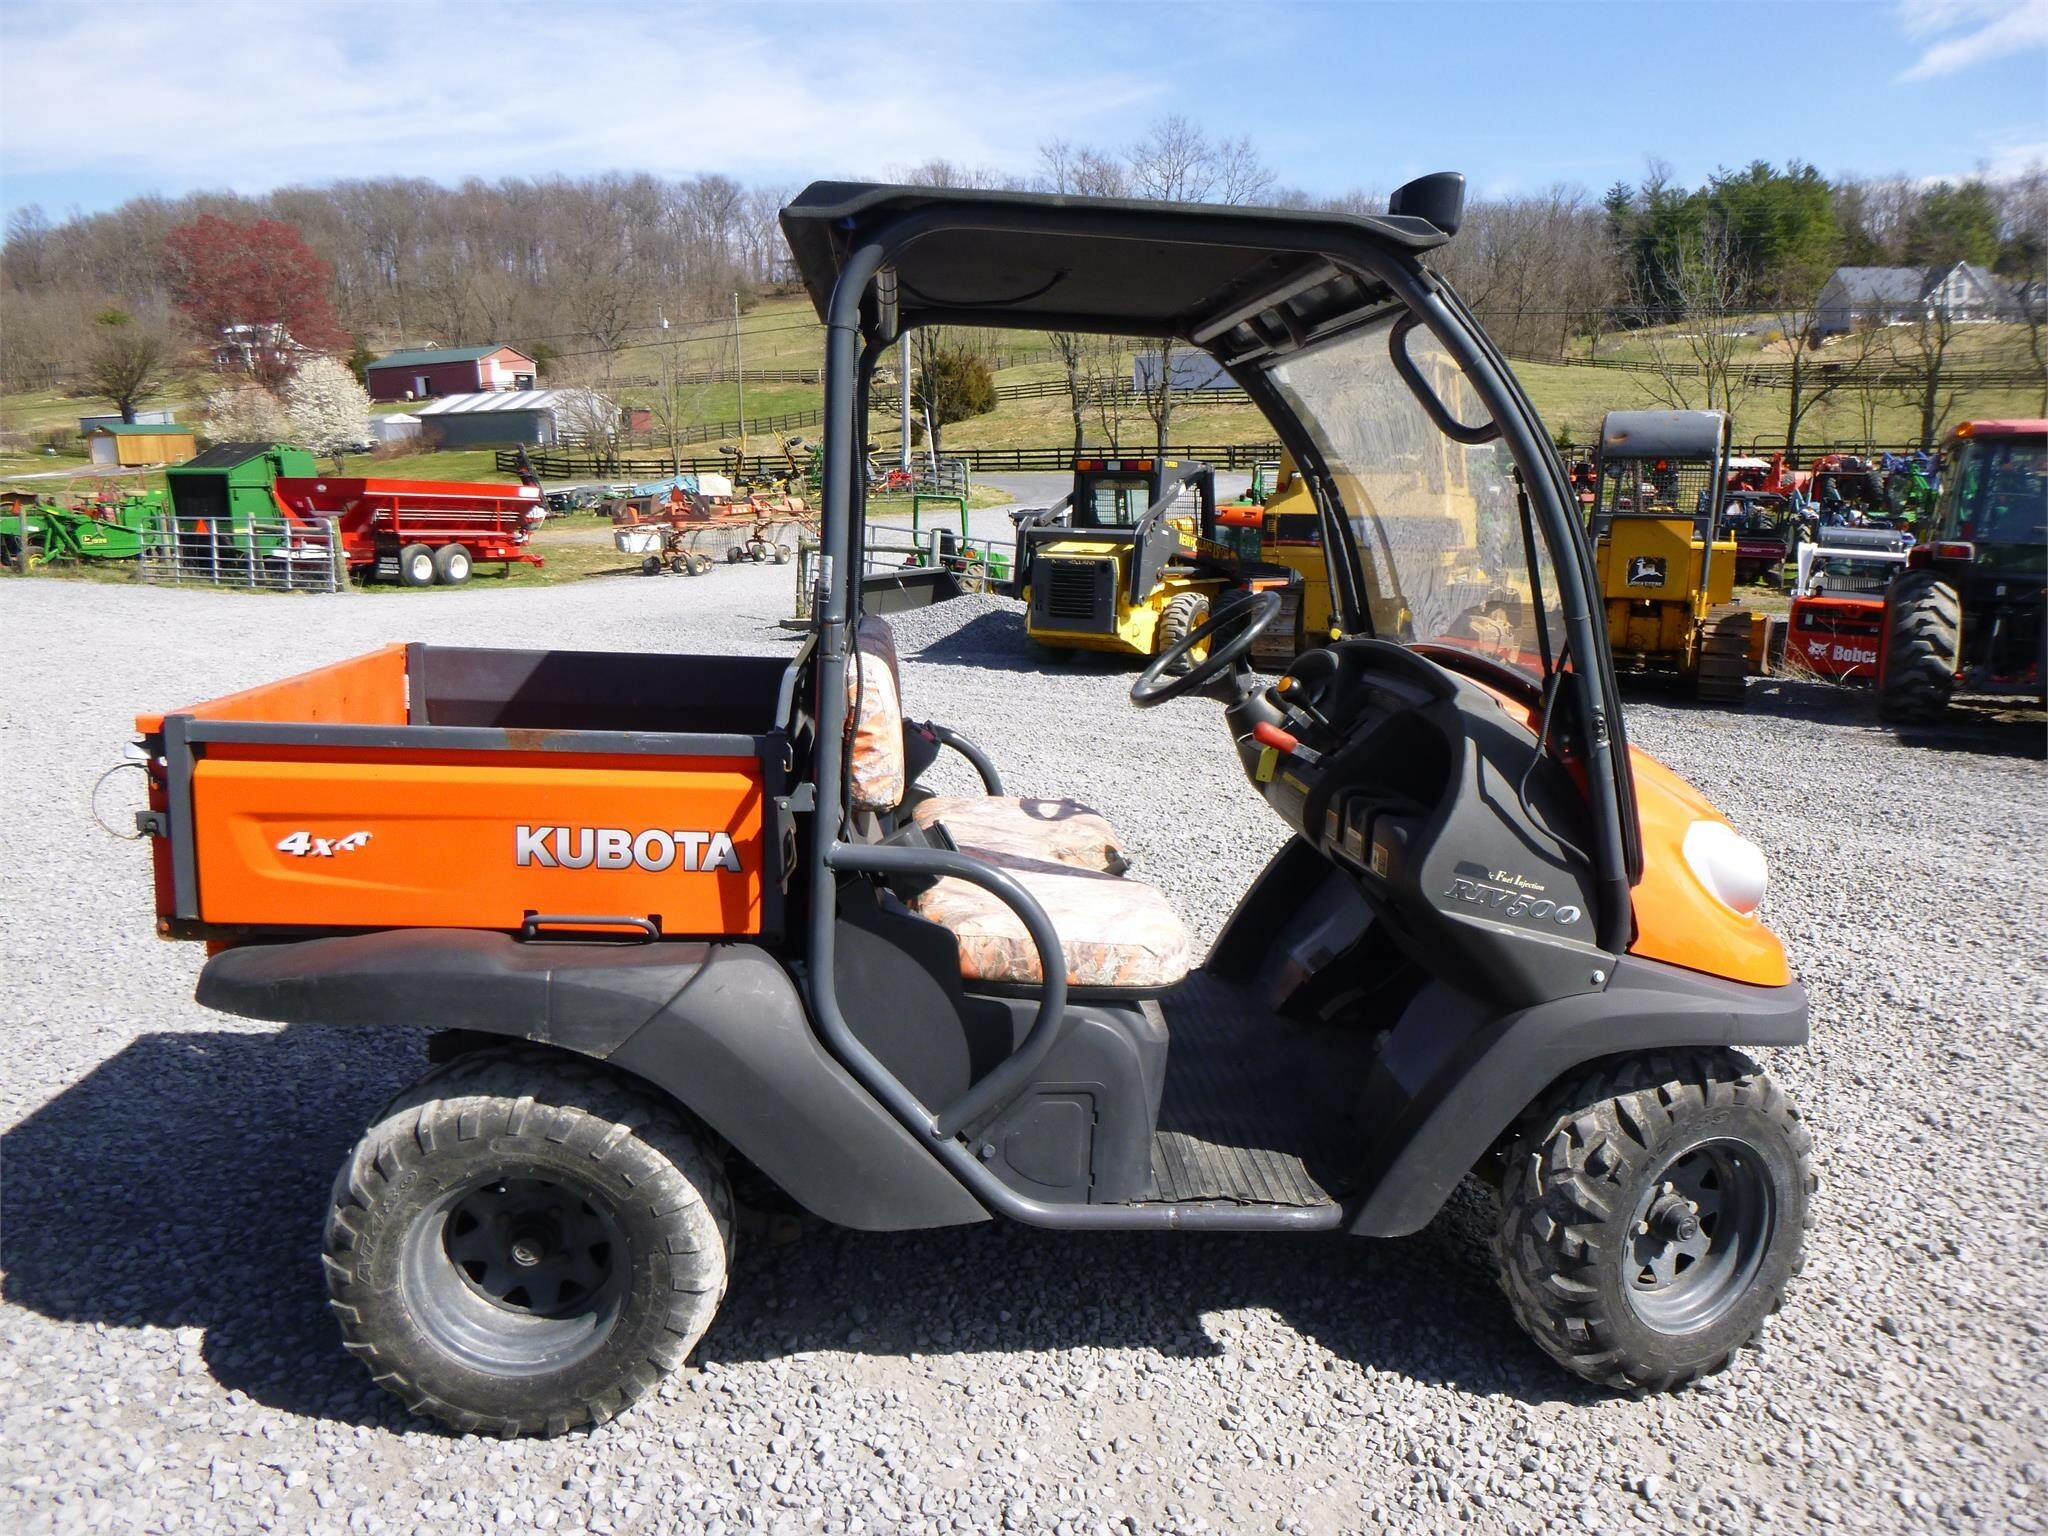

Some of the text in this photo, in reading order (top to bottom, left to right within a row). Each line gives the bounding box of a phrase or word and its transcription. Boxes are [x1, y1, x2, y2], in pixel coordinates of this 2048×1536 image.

[1832, 645, 1877, 663] Bobca
[277, 831, 373, 857] 4x4
[516, 825, 743, 872] KUBOTA
[1495, 870, 1514, 884] Fuel
[1513, 874, 1545, 891] Injection
